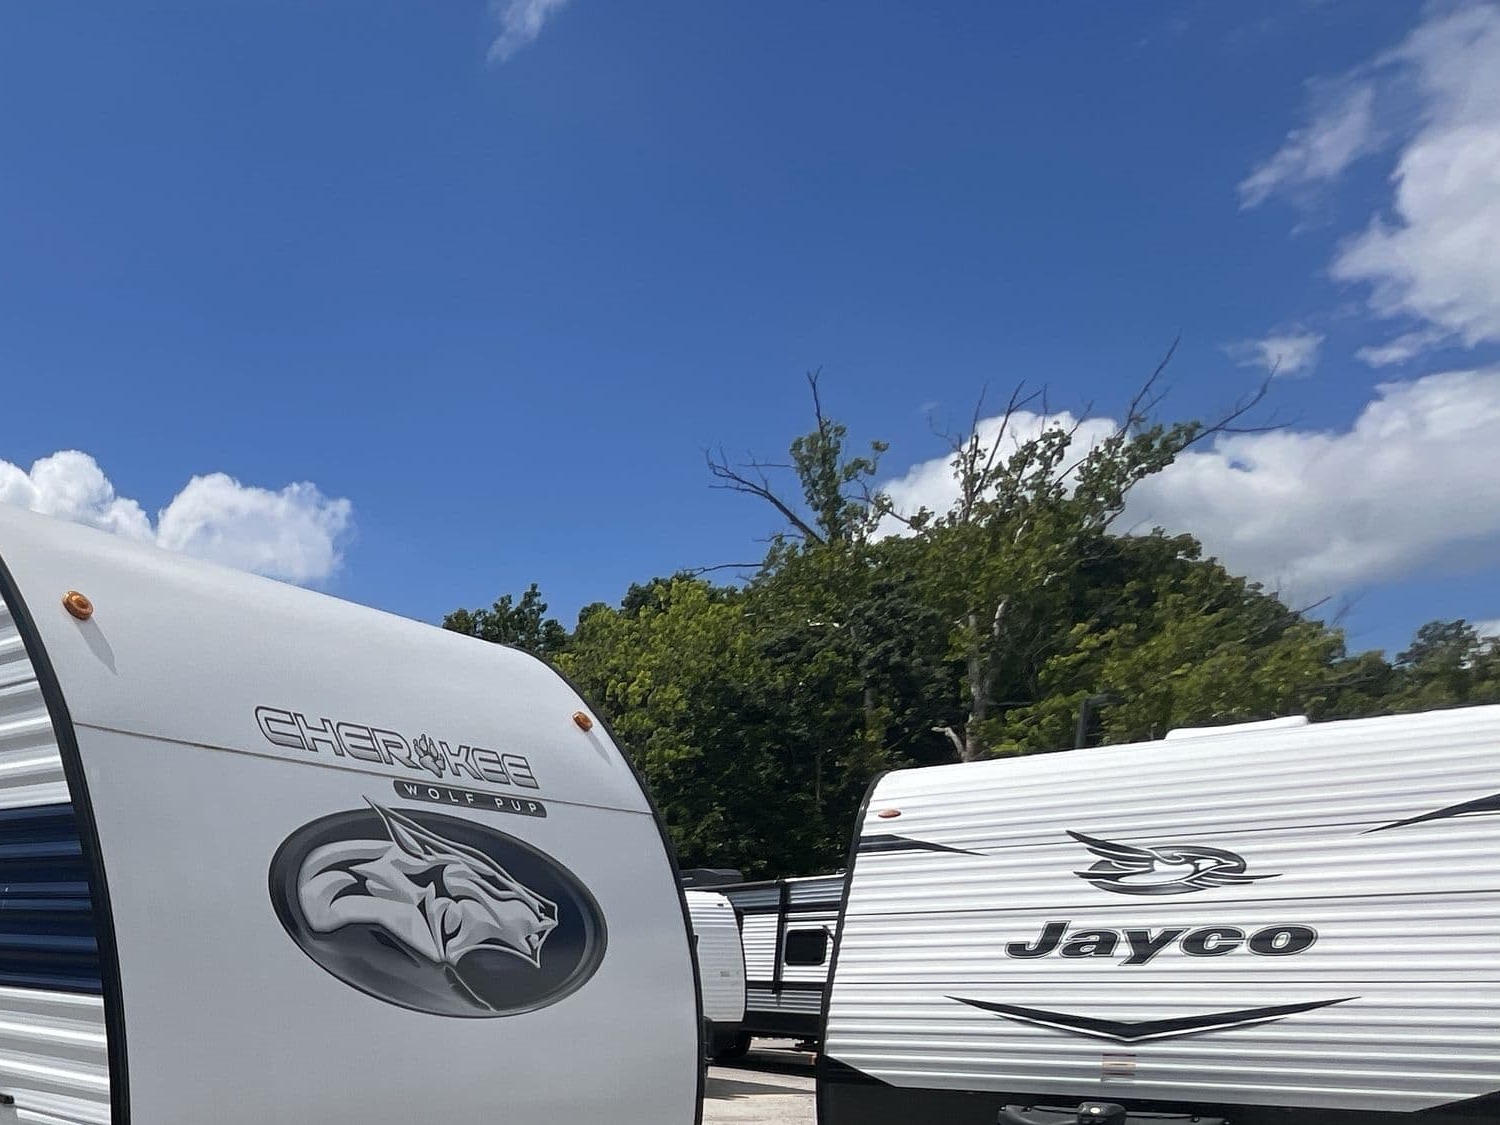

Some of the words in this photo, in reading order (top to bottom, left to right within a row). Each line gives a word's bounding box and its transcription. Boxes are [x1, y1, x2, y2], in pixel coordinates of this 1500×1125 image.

[403, 783, 474, 804] WOLF
[495, 798, 537, 813] PUP
[1004, 920, 1318, 966] Jayco
